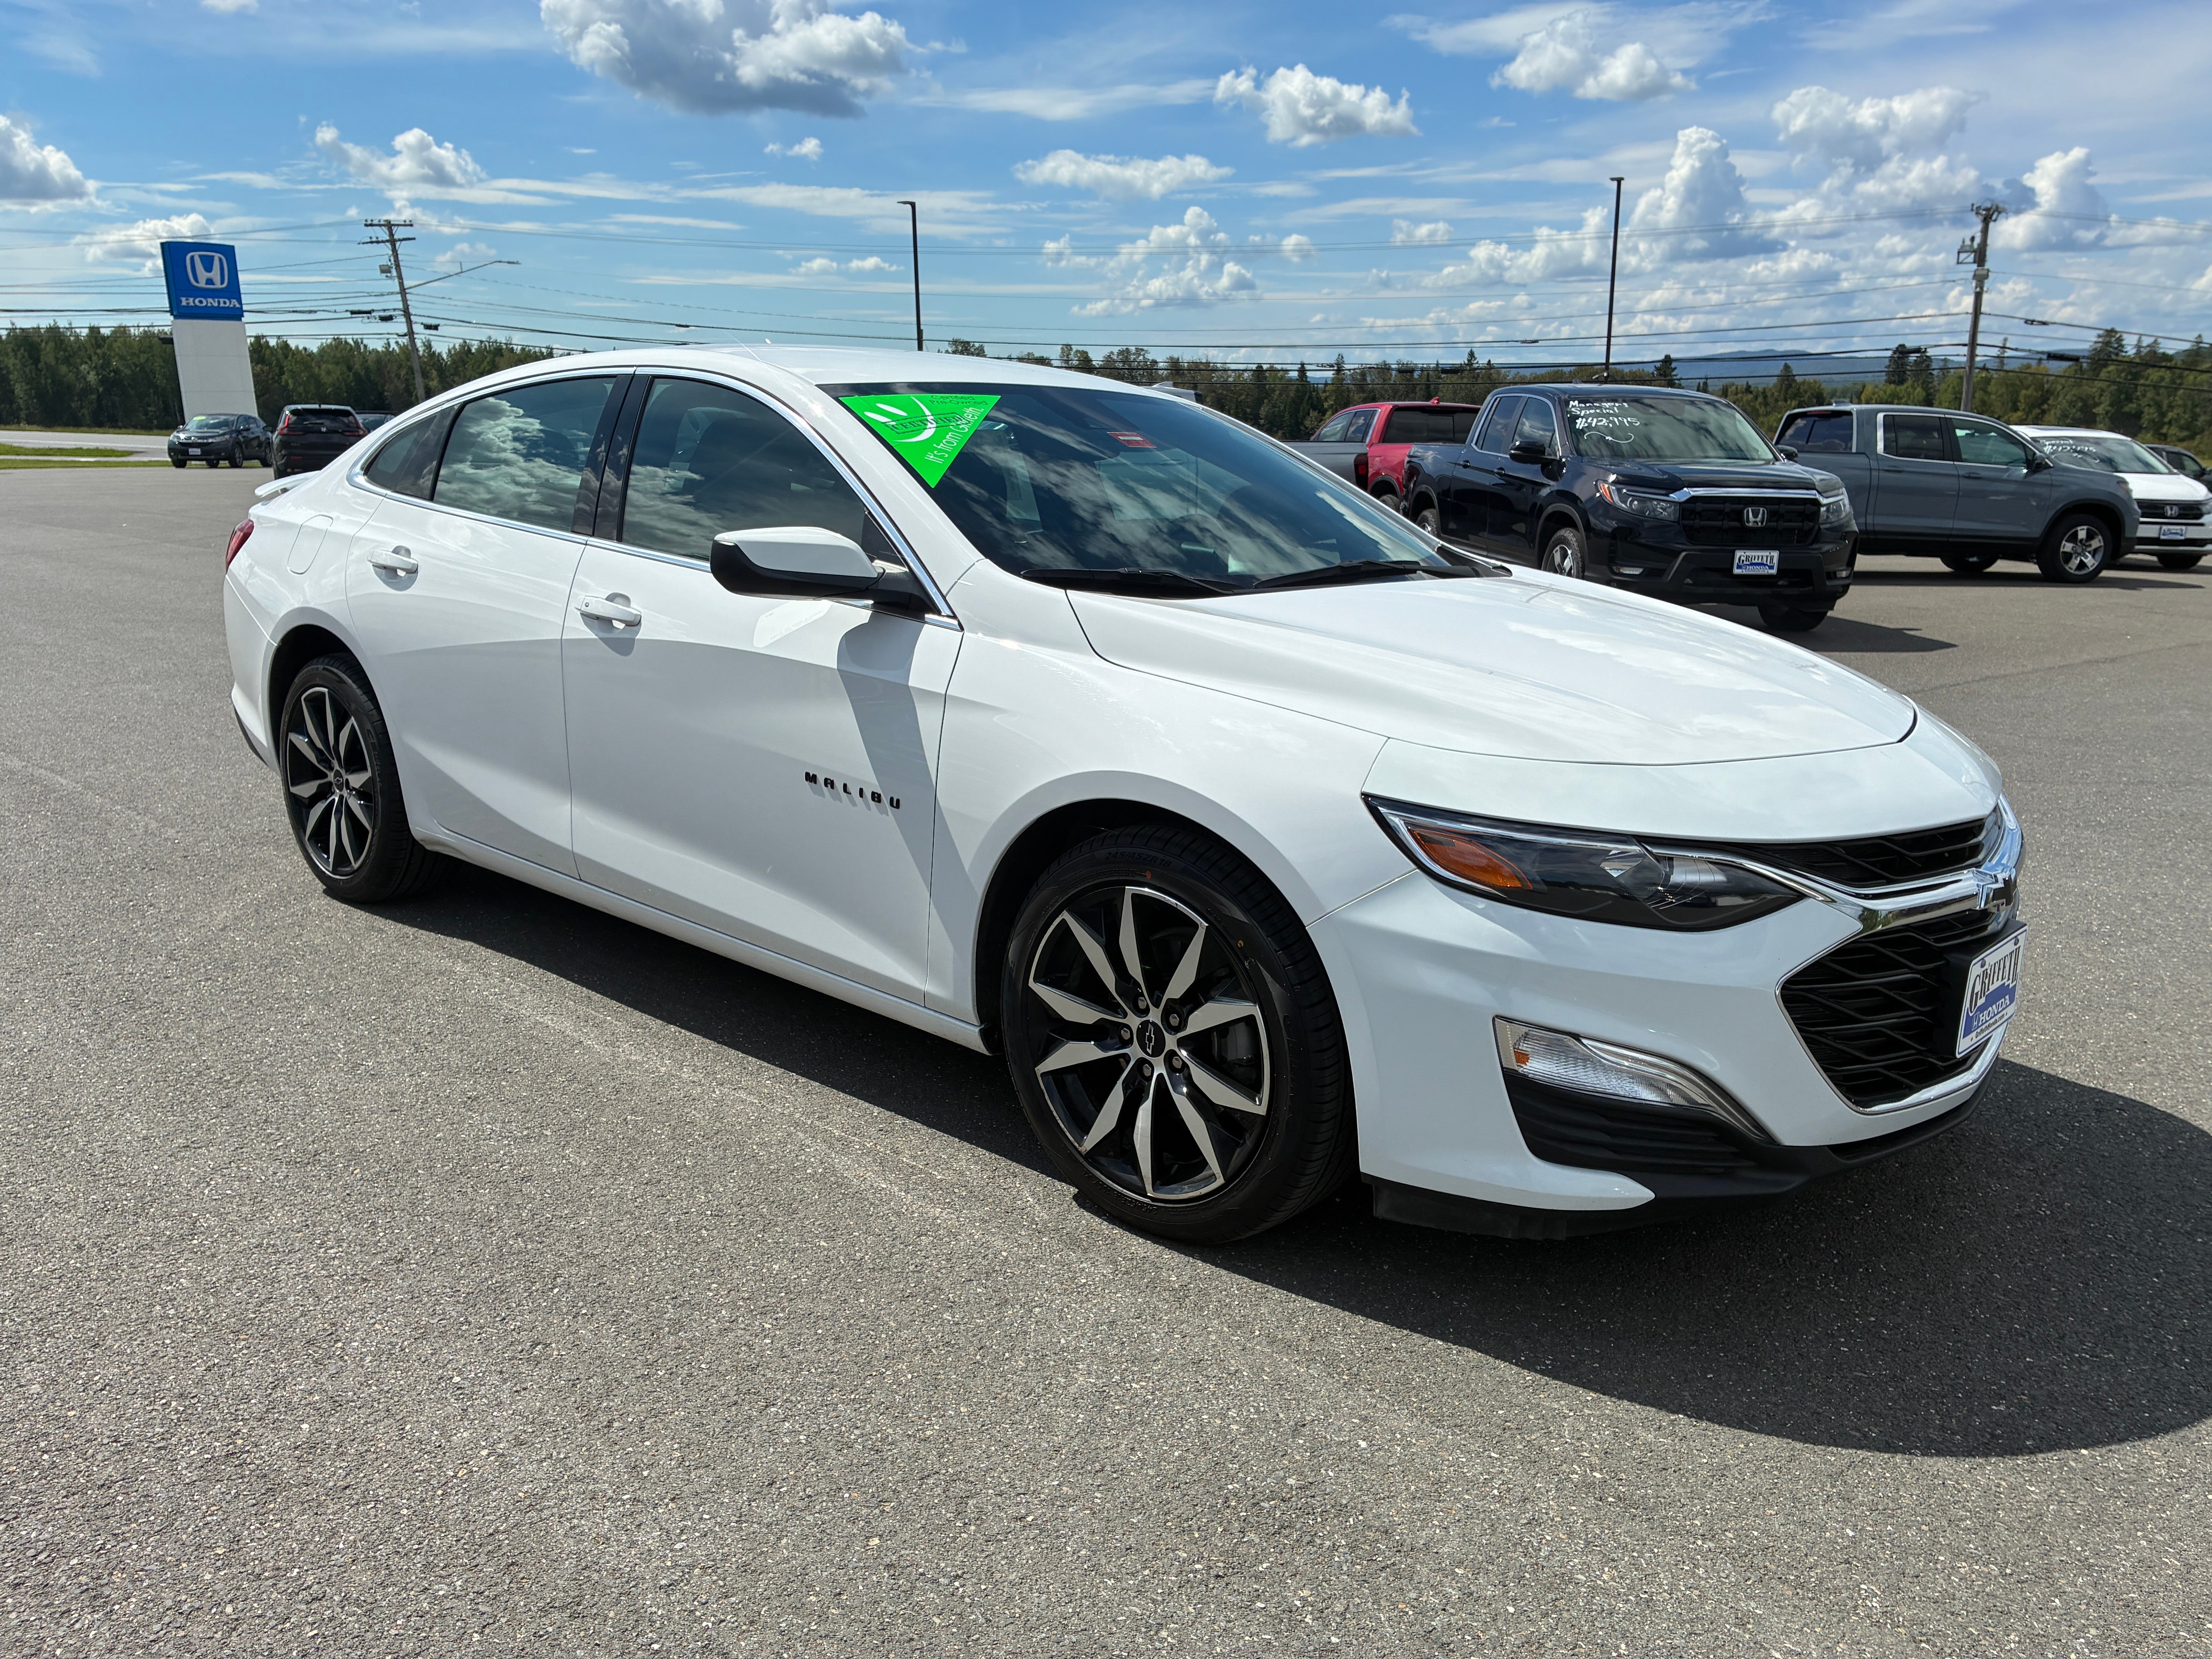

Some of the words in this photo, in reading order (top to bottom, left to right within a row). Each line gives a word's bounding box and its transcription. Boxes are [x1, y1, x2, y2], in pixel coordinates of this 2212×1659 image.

[180, 297, 241, 307] HONDA
[1571, 407, 1619, 416] Special
[933, 432, 963, 452] from
[924, 451, 948, 464] It's
[805, 771, 900, 809] MALIBU
[1969, 945, 2021, 1014] GRIFFETH
[1979, 994, 2010, 1027] HONDA
